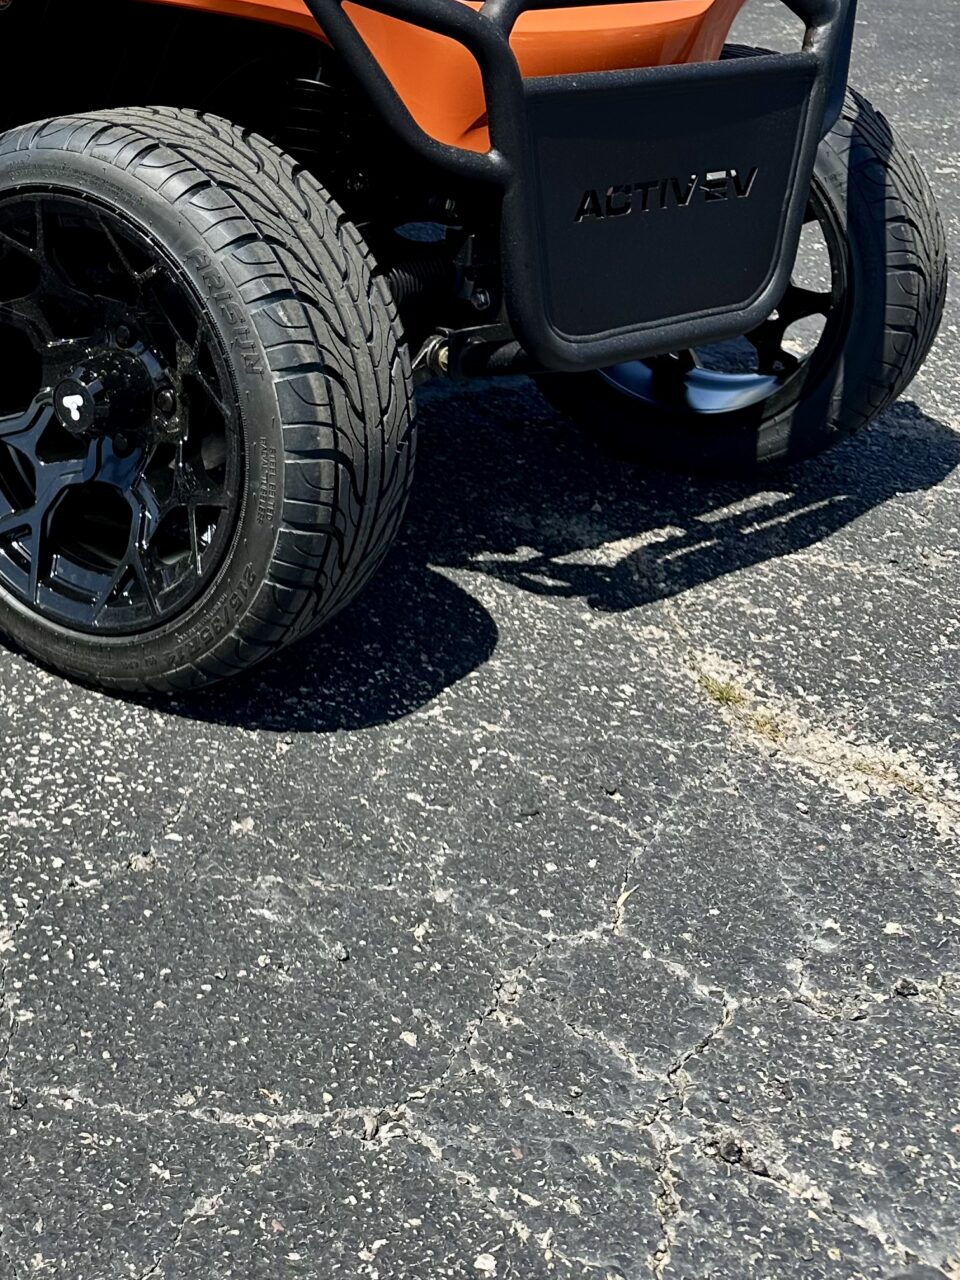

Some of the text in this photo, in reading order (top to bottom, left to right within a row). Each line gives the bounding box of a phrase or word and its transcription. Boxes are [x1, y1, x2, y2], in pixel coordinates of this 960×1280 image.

[183, 248, 265, 376] ARISUN
[266, 447, 277, 521] STEEL BELTED
